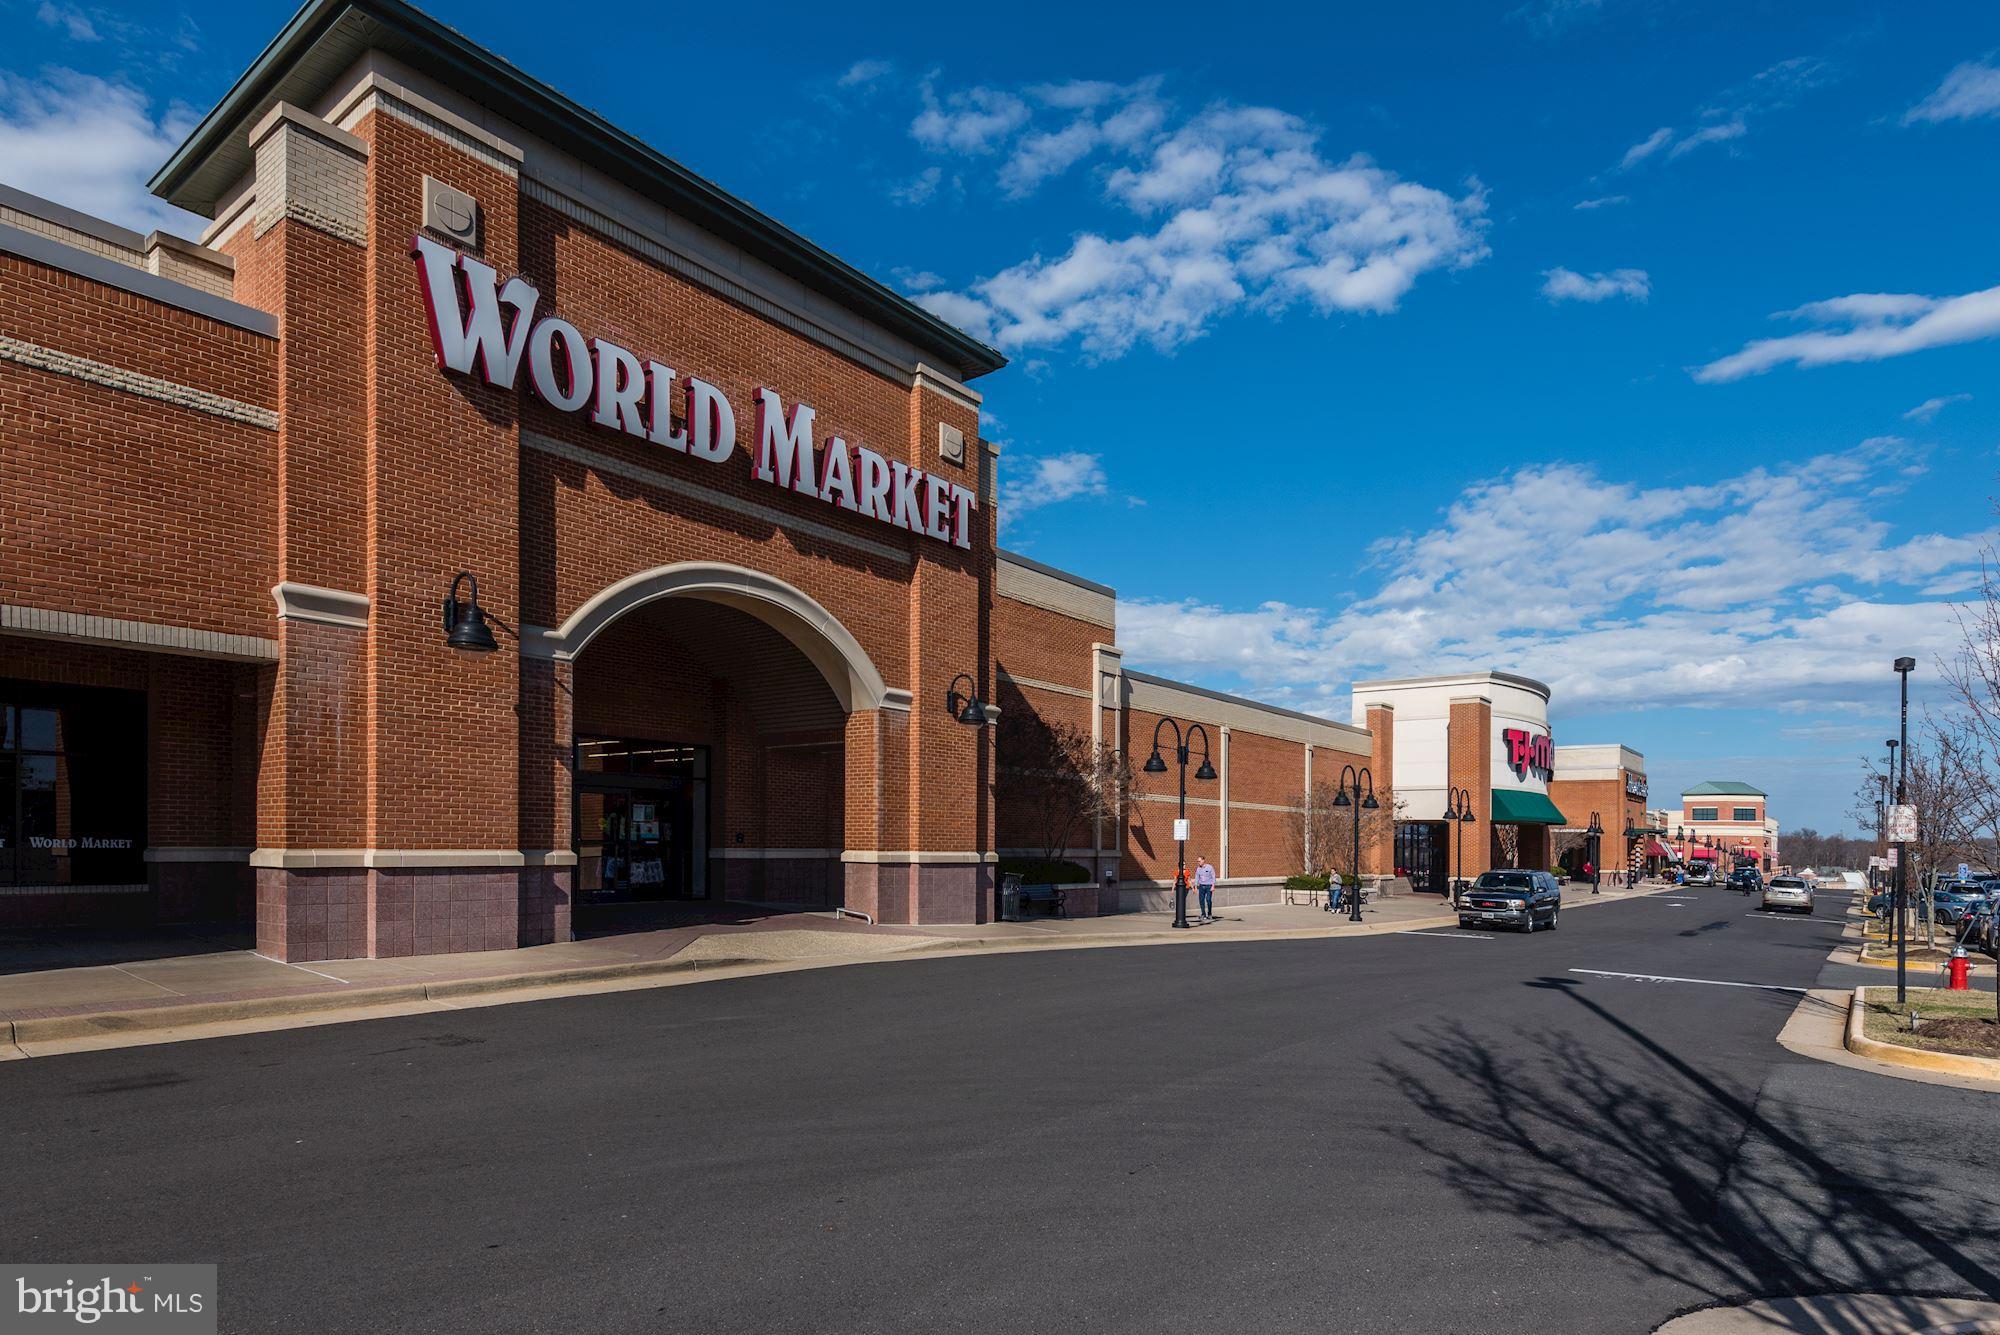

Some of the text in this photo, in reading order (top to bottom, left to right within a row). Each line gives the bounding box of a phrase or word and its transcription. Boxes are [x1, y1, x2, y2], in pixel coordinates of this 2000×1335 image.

[409, 234, 976, 550] WORLD MARKET
[29, 836, 133, 849] WORLD MARKET
